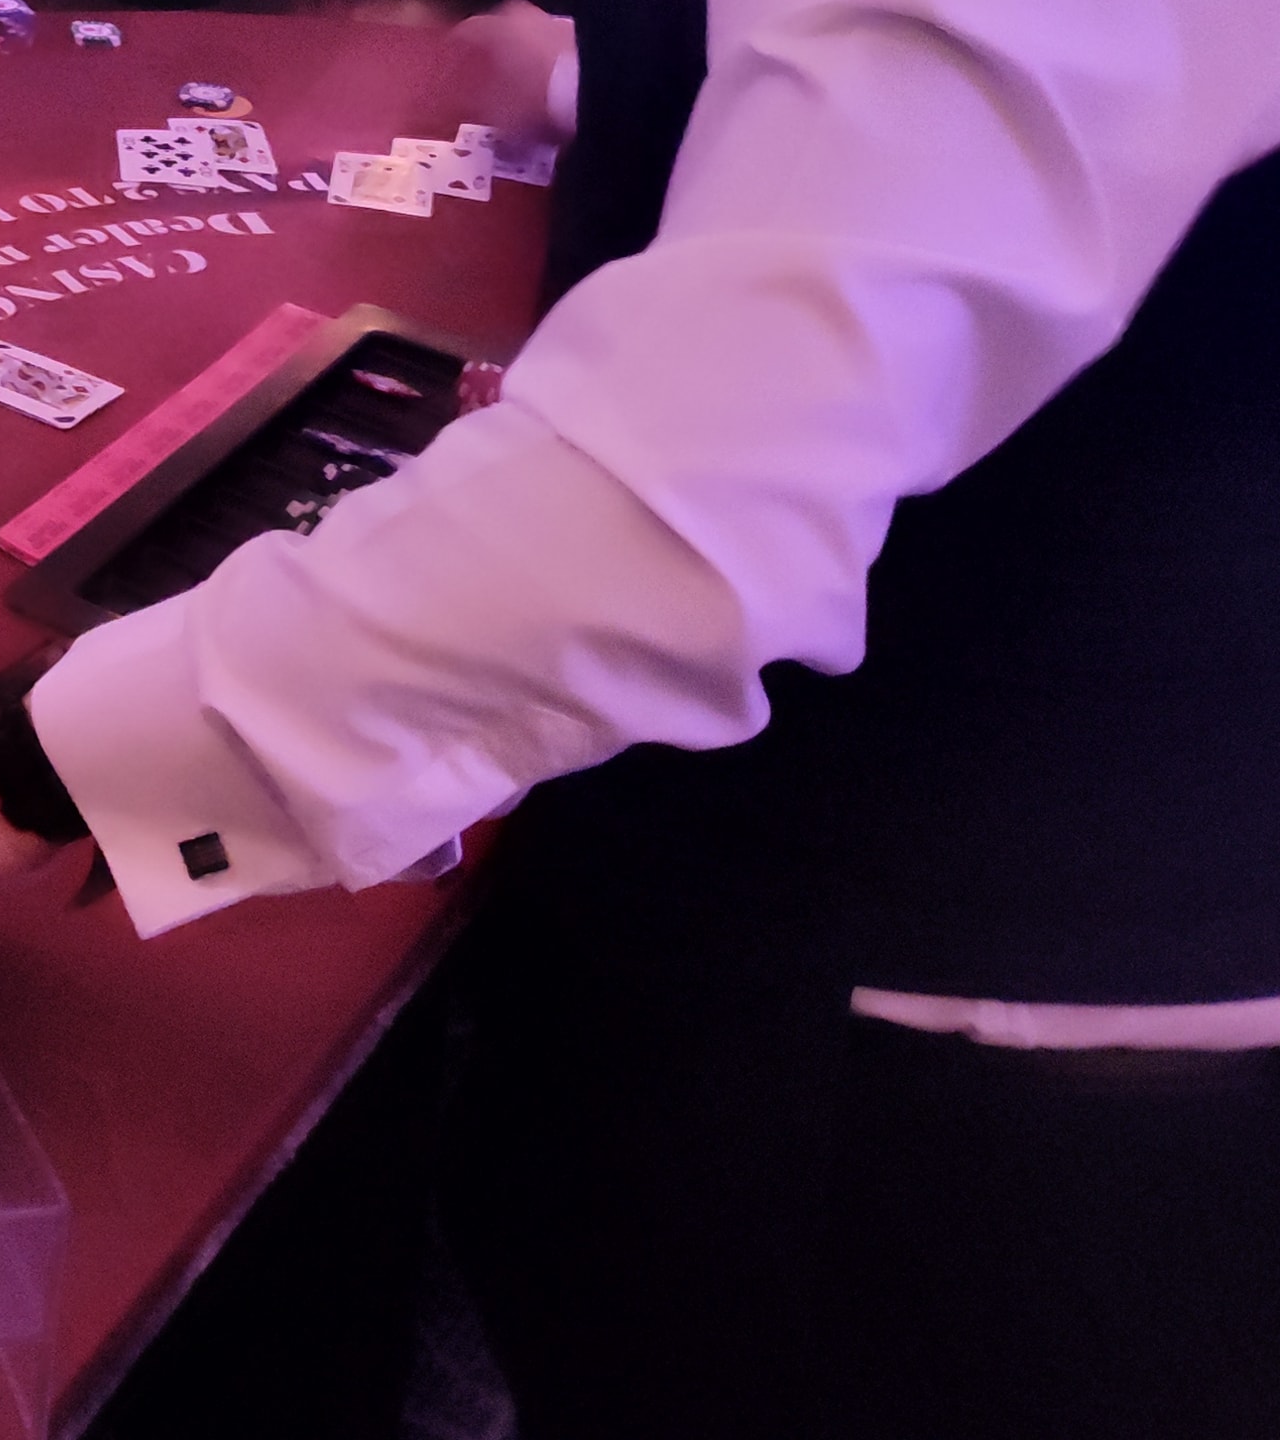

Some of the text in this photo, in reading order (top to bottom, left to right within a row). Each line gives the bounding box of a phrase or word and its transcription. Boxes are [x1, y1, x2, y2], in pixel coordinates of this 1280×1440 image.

[18, 186, 116, 214] TO
[111, 181, 159, 201] 2
[42, 211, 276, 254] Dealer
